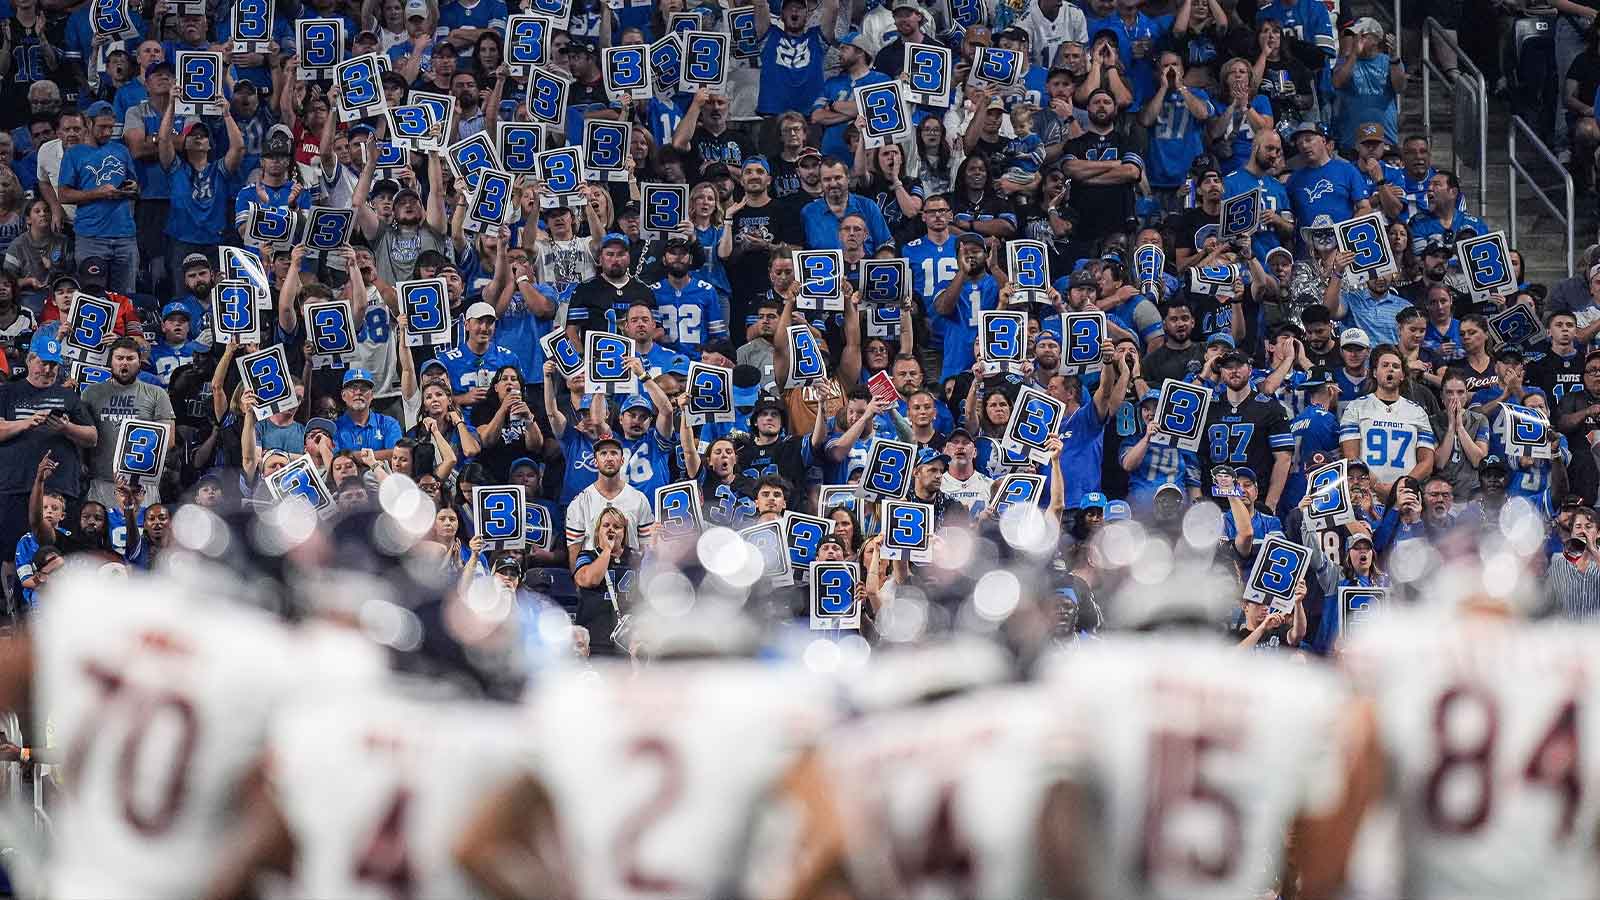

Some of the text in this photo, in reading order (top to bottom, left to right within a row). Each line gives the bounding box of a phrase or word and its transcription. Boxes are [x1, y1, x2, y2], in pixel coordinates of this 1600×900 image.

[96, 0, 125, 32] 3
[240, 0, 267, 37] 3
[305, 24, 335, 66] 3
[513, 21, 543, 64] 3
[651, 42, 683, 83] 3
[690, 38, 721, 80] 3
[185, 56, 215, 100] 3
[343, 63, 378, 105] 3
[612, 49, 643, 87] 3
[912, 49, 944, 91] 3
[534, 76, 561, 120] 3
[867, 90, 902, 133] 3
[398, 107, 430, 136] 3
[507, 128, 538, 172] 3
[591, 126, 622, 168] 3
[545, 153, 576, 194] 3
[478, 176, 507, 220] 3
[649, 190, 681, 229] 3
[1228, 197, 1255, 234] 3
[257, 204, 289, 240] 3
[313, 213, 348, 249] 3
[1346, 222, 1384, 268] 3
[1469, 240, 1506, 287] 3
[804, 255, 836, 295] 3
[869, 264, 901, 300] 3
[921, 258, 960, 297] 16
[1015, 245, 1045, 288] 3
[74, 302, 109, 347] 3
[220, 286, 251, 331] 3
[314, 308, 347, 351] 3
[407, 286, 442, 331] 3
[658, 304, 702, 344] 32
[968, 290, 981, 327] 1
[595, 337, 627, 379] 3
[795, 331, 822, 377] 3
[989, 317, 1020, 359] 3
[1071, 318, 1102, 362] 3
[250, 355, 286, 402] 3
[694, 370, 726, 411] 3
[1017, 397, 1056, 444] 3
[1163, 388, 1201, 433] 3
[1372, 420, 1404, 429] DETROIT
[123, 427, 159, 472] 3
[1208, 423, 1255, 463] 87
[1366, 428, 1414, 468] 97
[872, 447, 908, 493] 3
[483, 492, 517, 539] 3
[893, 506, 925, 546] 3
[789, 521, 823, 569] 3
[821, 567, 854, 614] 3
[1261, 546, 1300, 594] 3
[1425, 686, 1586, 840] 84
